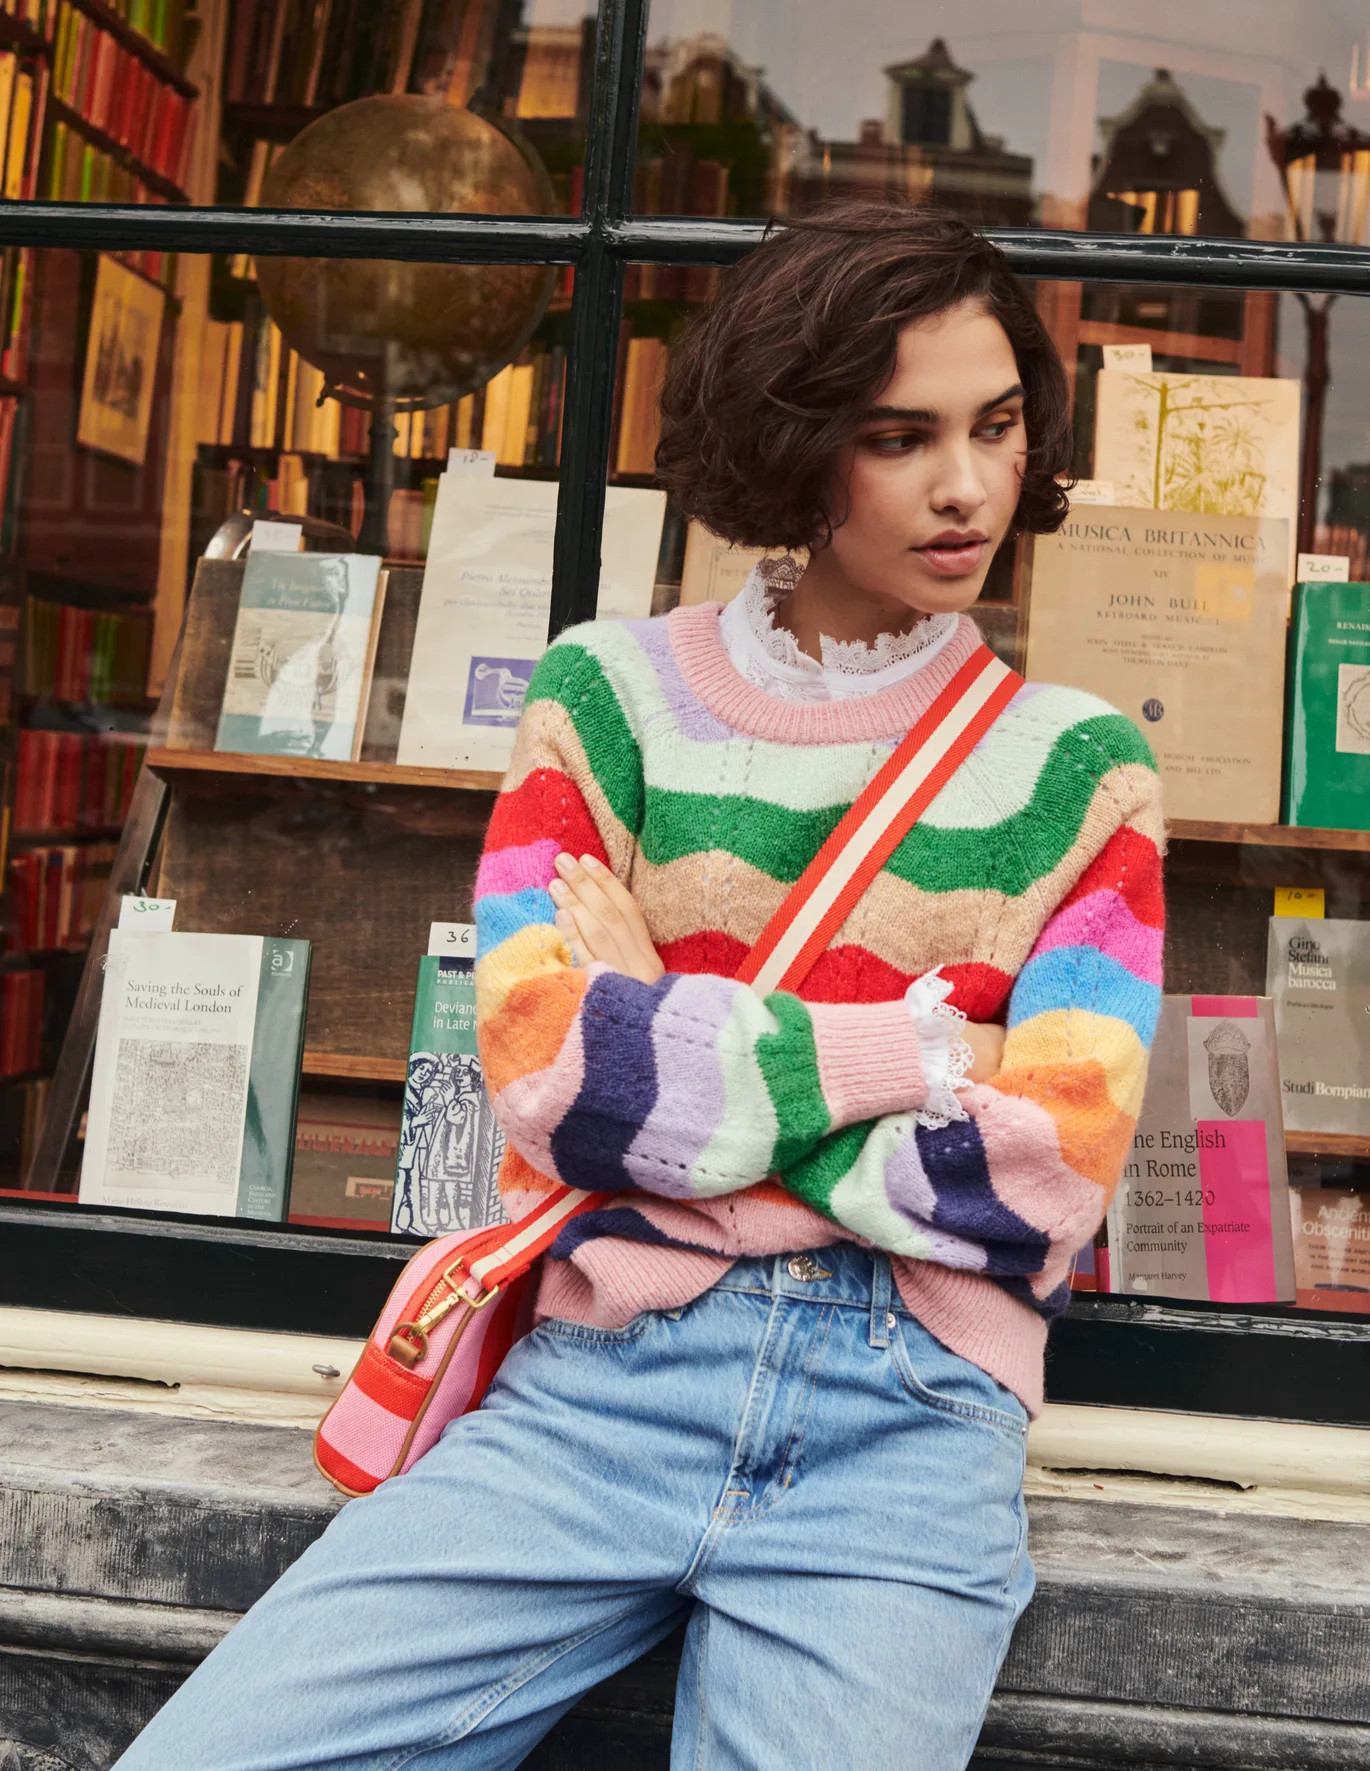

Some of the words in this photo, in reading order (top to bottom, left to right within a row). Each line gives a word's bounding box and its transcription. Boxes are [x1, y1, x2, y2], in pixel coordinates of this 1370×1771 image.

[1058, 523, 1131, 542] MUSICA
[1145, 528, 1267, 551] BRITANNICA
[1070, 543, 1127, 555] NATIONAL
[1134, 547, 1206, 560] COLLECTION
[1212, 553, 1226, 561] OF
[1108, 593, 1155, 607] JOHN
[1169, 597, 1209, 611] BULL
[1097, 610, 1157, 622] KEYBOARD
[446, 929, 470, 943] 36
[437, 969, 457, 979] PAST
[458, 971, 465, 979] &
[1288, 962, 1333, 977] Musica
[127, 980, 167, 996] Saving
[171, 983, 191, 995] the
[193, 984, 226, 997] Souls
[229, 985, 244, 997] of
[1287, 977, 1337, 990] barocca
[125, 997, 180, 1011] Medieval
[185, 999, 232, 1014] London
[433, 1016, 444, 1029] in
[446, 1018, 470, 1030] Late
[1160, 1128, 1227, 1154] English
[1146, 1159, 1197, 1178] Rome
[1126, 1222, 1164, 1234] Portrait
[1167, 1221, 1179, 1233] of
[1181, 1224, 1194, 1233] an
[1197, 1221, 1250, 1236] Expatriate
[1126, 1239, 1188, 1254] Community
[1161, 1271, 1187, 1282] Harvey
